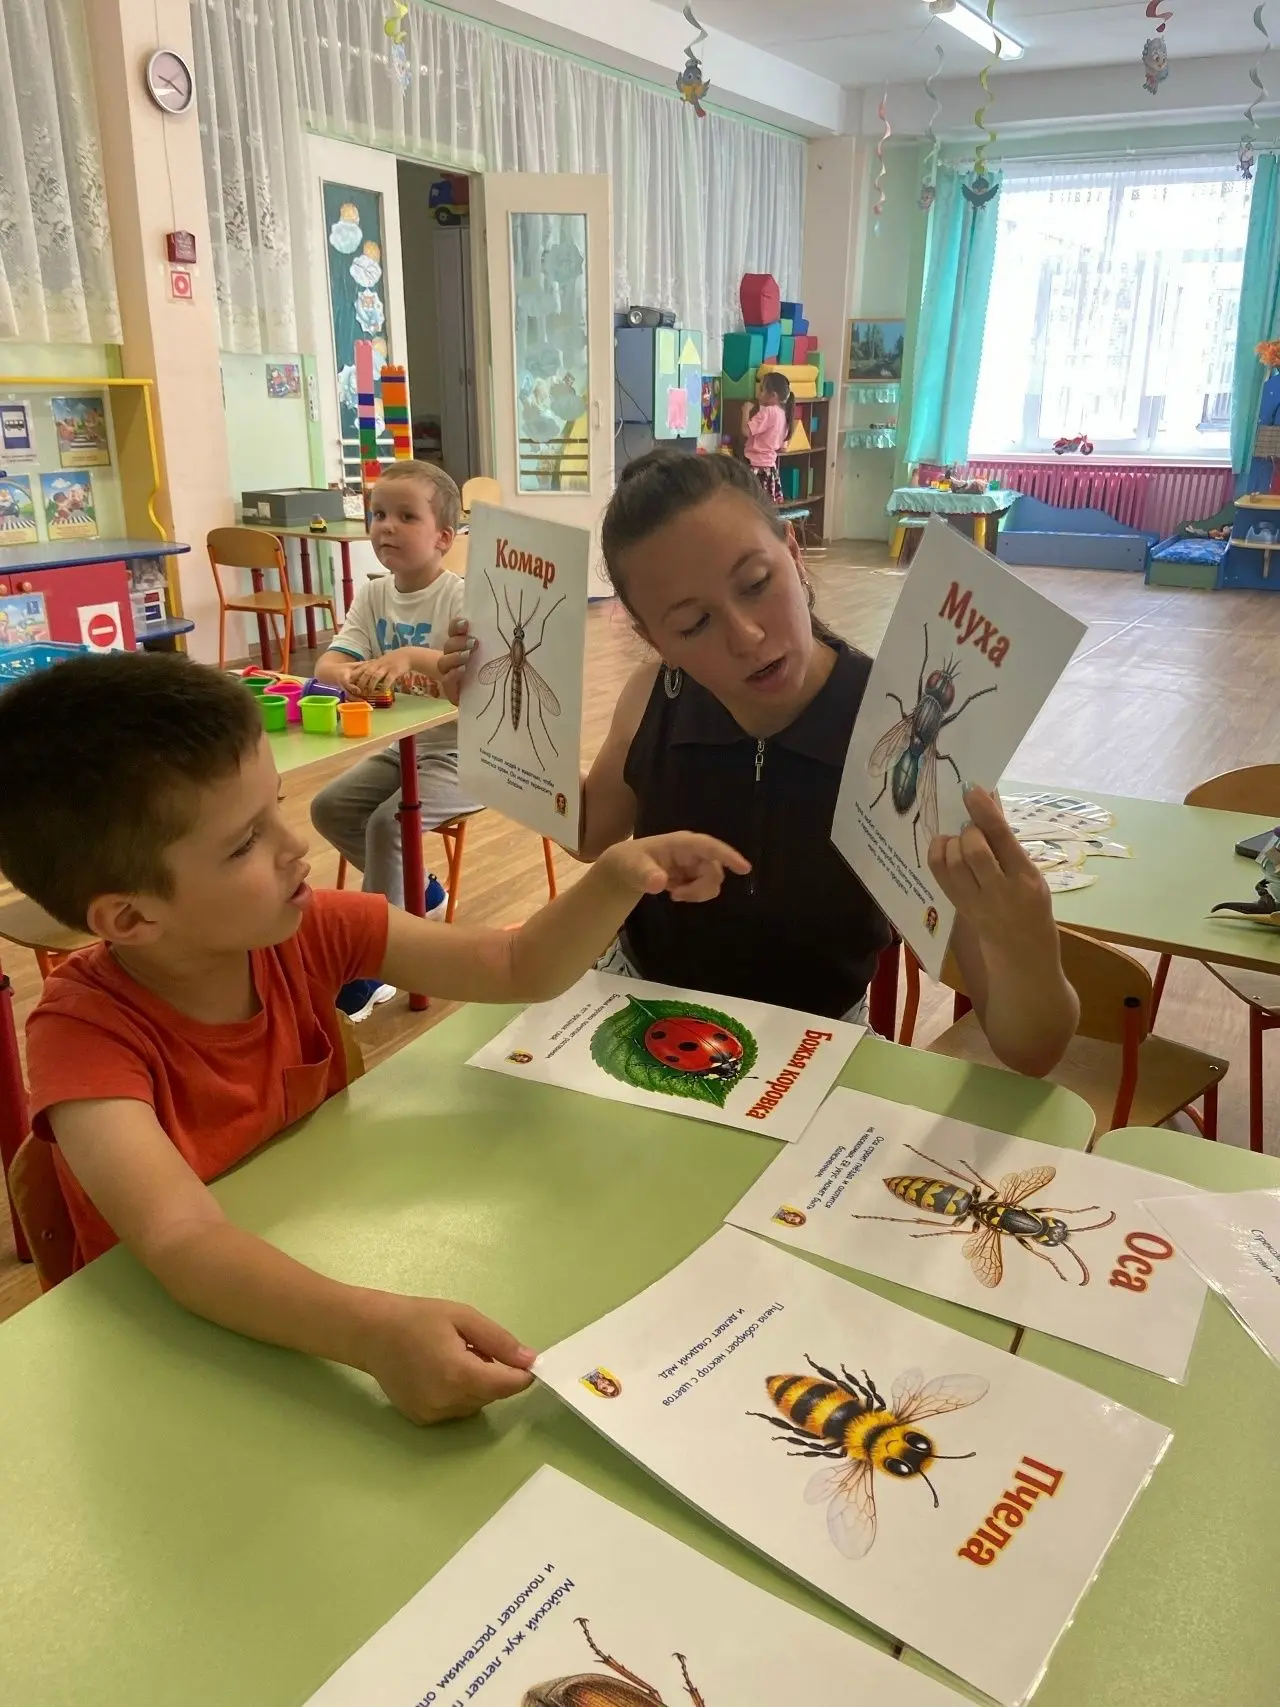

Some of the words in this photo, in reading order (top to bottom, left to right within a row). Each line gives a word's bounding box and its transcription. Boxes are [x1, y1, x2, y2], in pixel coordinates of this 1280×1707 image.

[495, 538, 556, 590] Комар
[938, 581, 1010, 668] Муха
[787, 1029, 833, 1070] Божья
[745, 1069, 801, 1120] коровка
[859, 1146, 875, 1162] строит
[871, 1136, 885, 1146] Оса
[830, 1166, 843, 1179] укус
[817, 1179, 833, 1196] может
[825, 1185, 845, 1208] охотится
[806, 1197, 822, 1210] быть
[1109, 1231, 1173, 1292] Оса
[711, 1313, 738, 1338] делает
[757, 1302, 784, 1323] Пчела
[677, 1337, 712, 1366] сладкий
[725, 1323, 759, 1354] собирает
[696, 1353, 726, 1378] нектар
[662, 1382, 693, 1406] цветов
[958, 1456, 1063, 1566] Пчела
[544, 1563, 555, 1573] и
[497, 1574, 545, 1626] помогает
[525, 1578, 575, 1631] Майский
[436, 1624, 497, 1688] растениям
[502, 1631, 526, 1655] жук
[465, 1656, 502, 1699] летает
